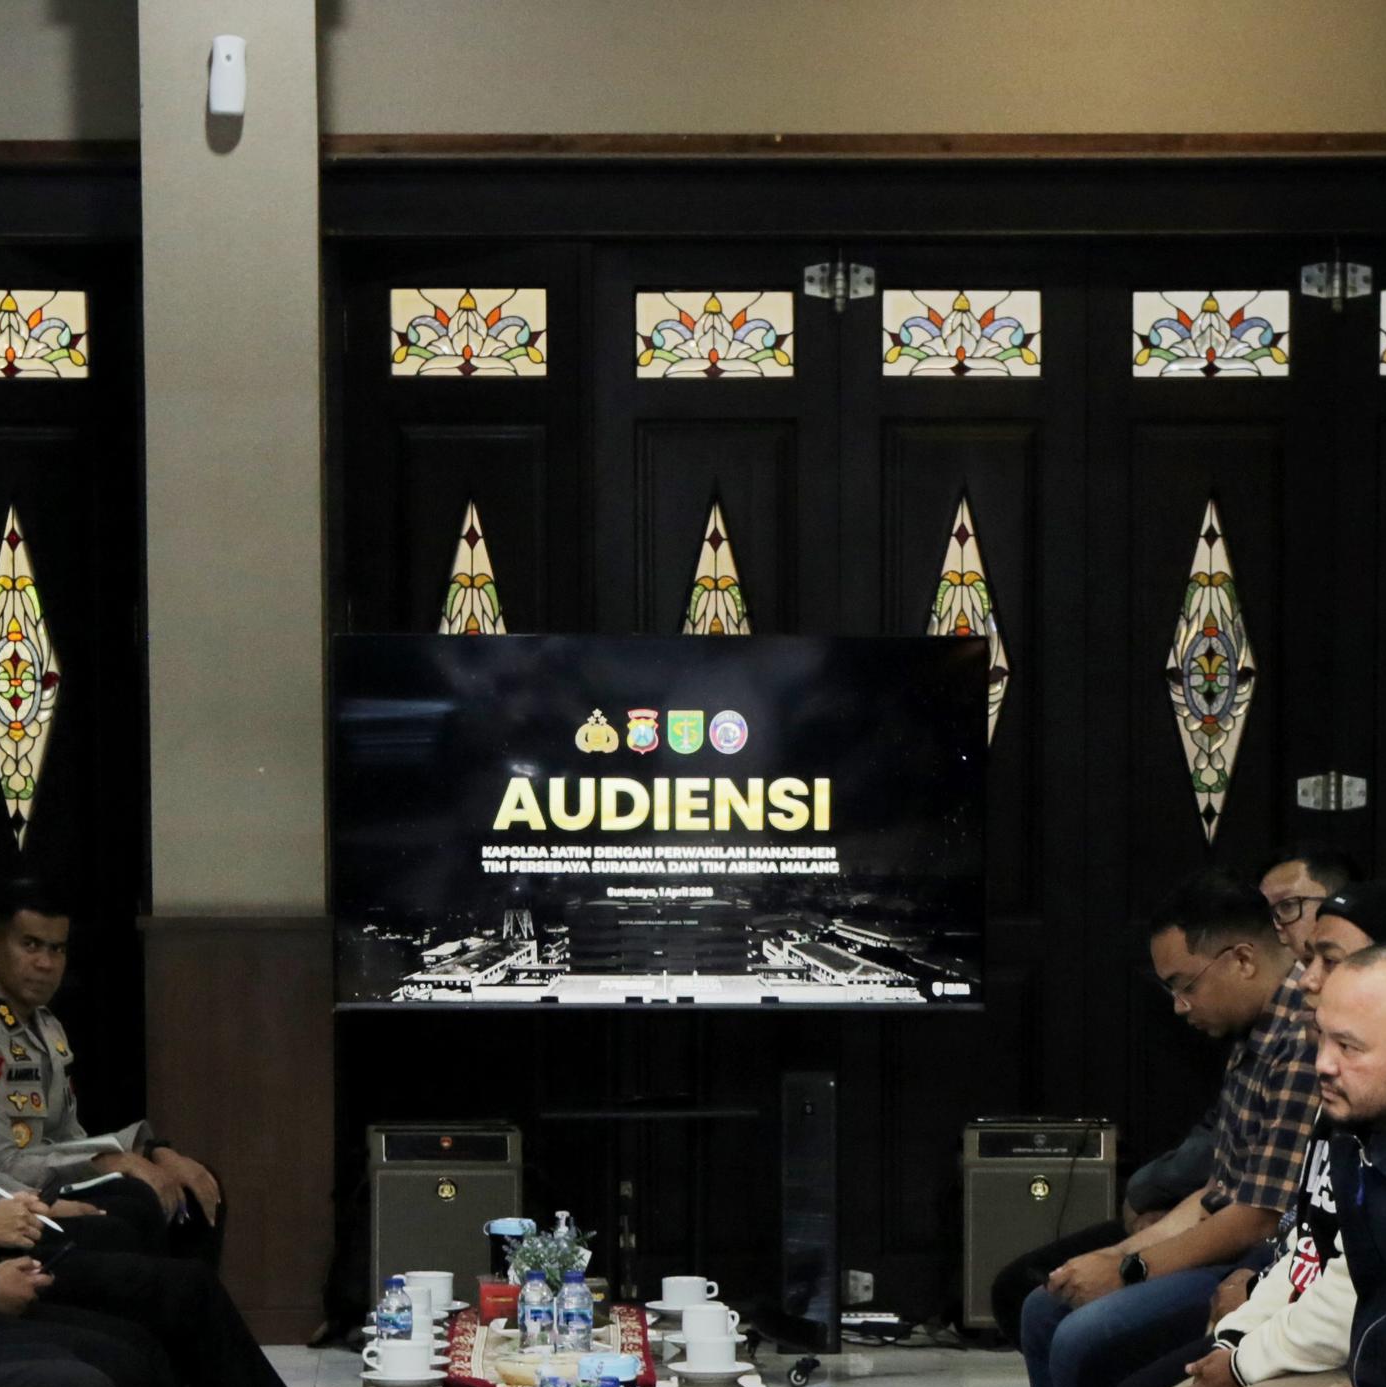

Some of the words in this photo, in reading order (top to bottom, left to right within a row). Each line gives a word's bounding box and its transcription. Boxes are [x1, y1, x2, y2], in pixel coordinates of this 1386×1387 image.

[493, 777, 830, 831] AUDIENSI
[482, 846, 549, 859] KAPOLDA
[550, 846, 592, 859] JATIM
[594, 846, 653, 859] DENGAN
[654, 846, 747, 859] PERWAKILAN
[748, 846, 836, 859] MANAJEMEN
[482, 860, 507, 873] TIM
[510, 860, 590, 873] PERSEBAYA
[591, 860, 666, 873] SURABAYA
[667, 860, 699, 873] DAN
[700, 861, 726, 873] TIM
[728, 861, 778, 873] AREMA
[780, 861, 839, 874] MALANG
[607, 886, 658, 899] Surabaya,
[664, 887, 689, 899] April
